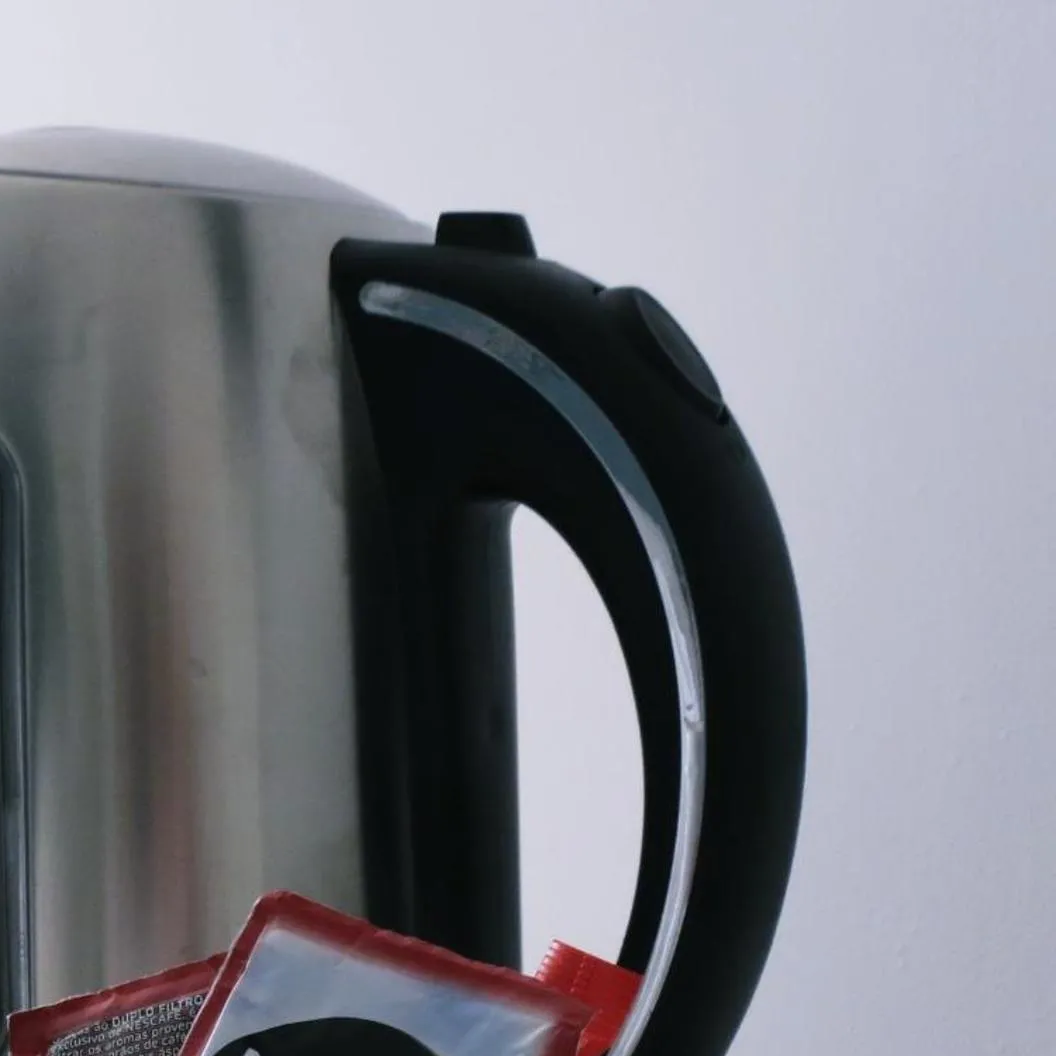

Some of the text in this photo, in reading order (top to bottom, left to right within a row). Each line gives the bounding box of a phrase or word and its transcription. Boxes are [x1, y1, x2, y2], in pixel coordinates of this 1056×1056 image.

[112, 1006, 154, 1028] DUPLO
[158, 994, 204, 1014] FILTRO
[88, 1044, 102, 1056] os
[104, 1031, 149, 1052] aromas
[142, 1037, 158, 1050] de
